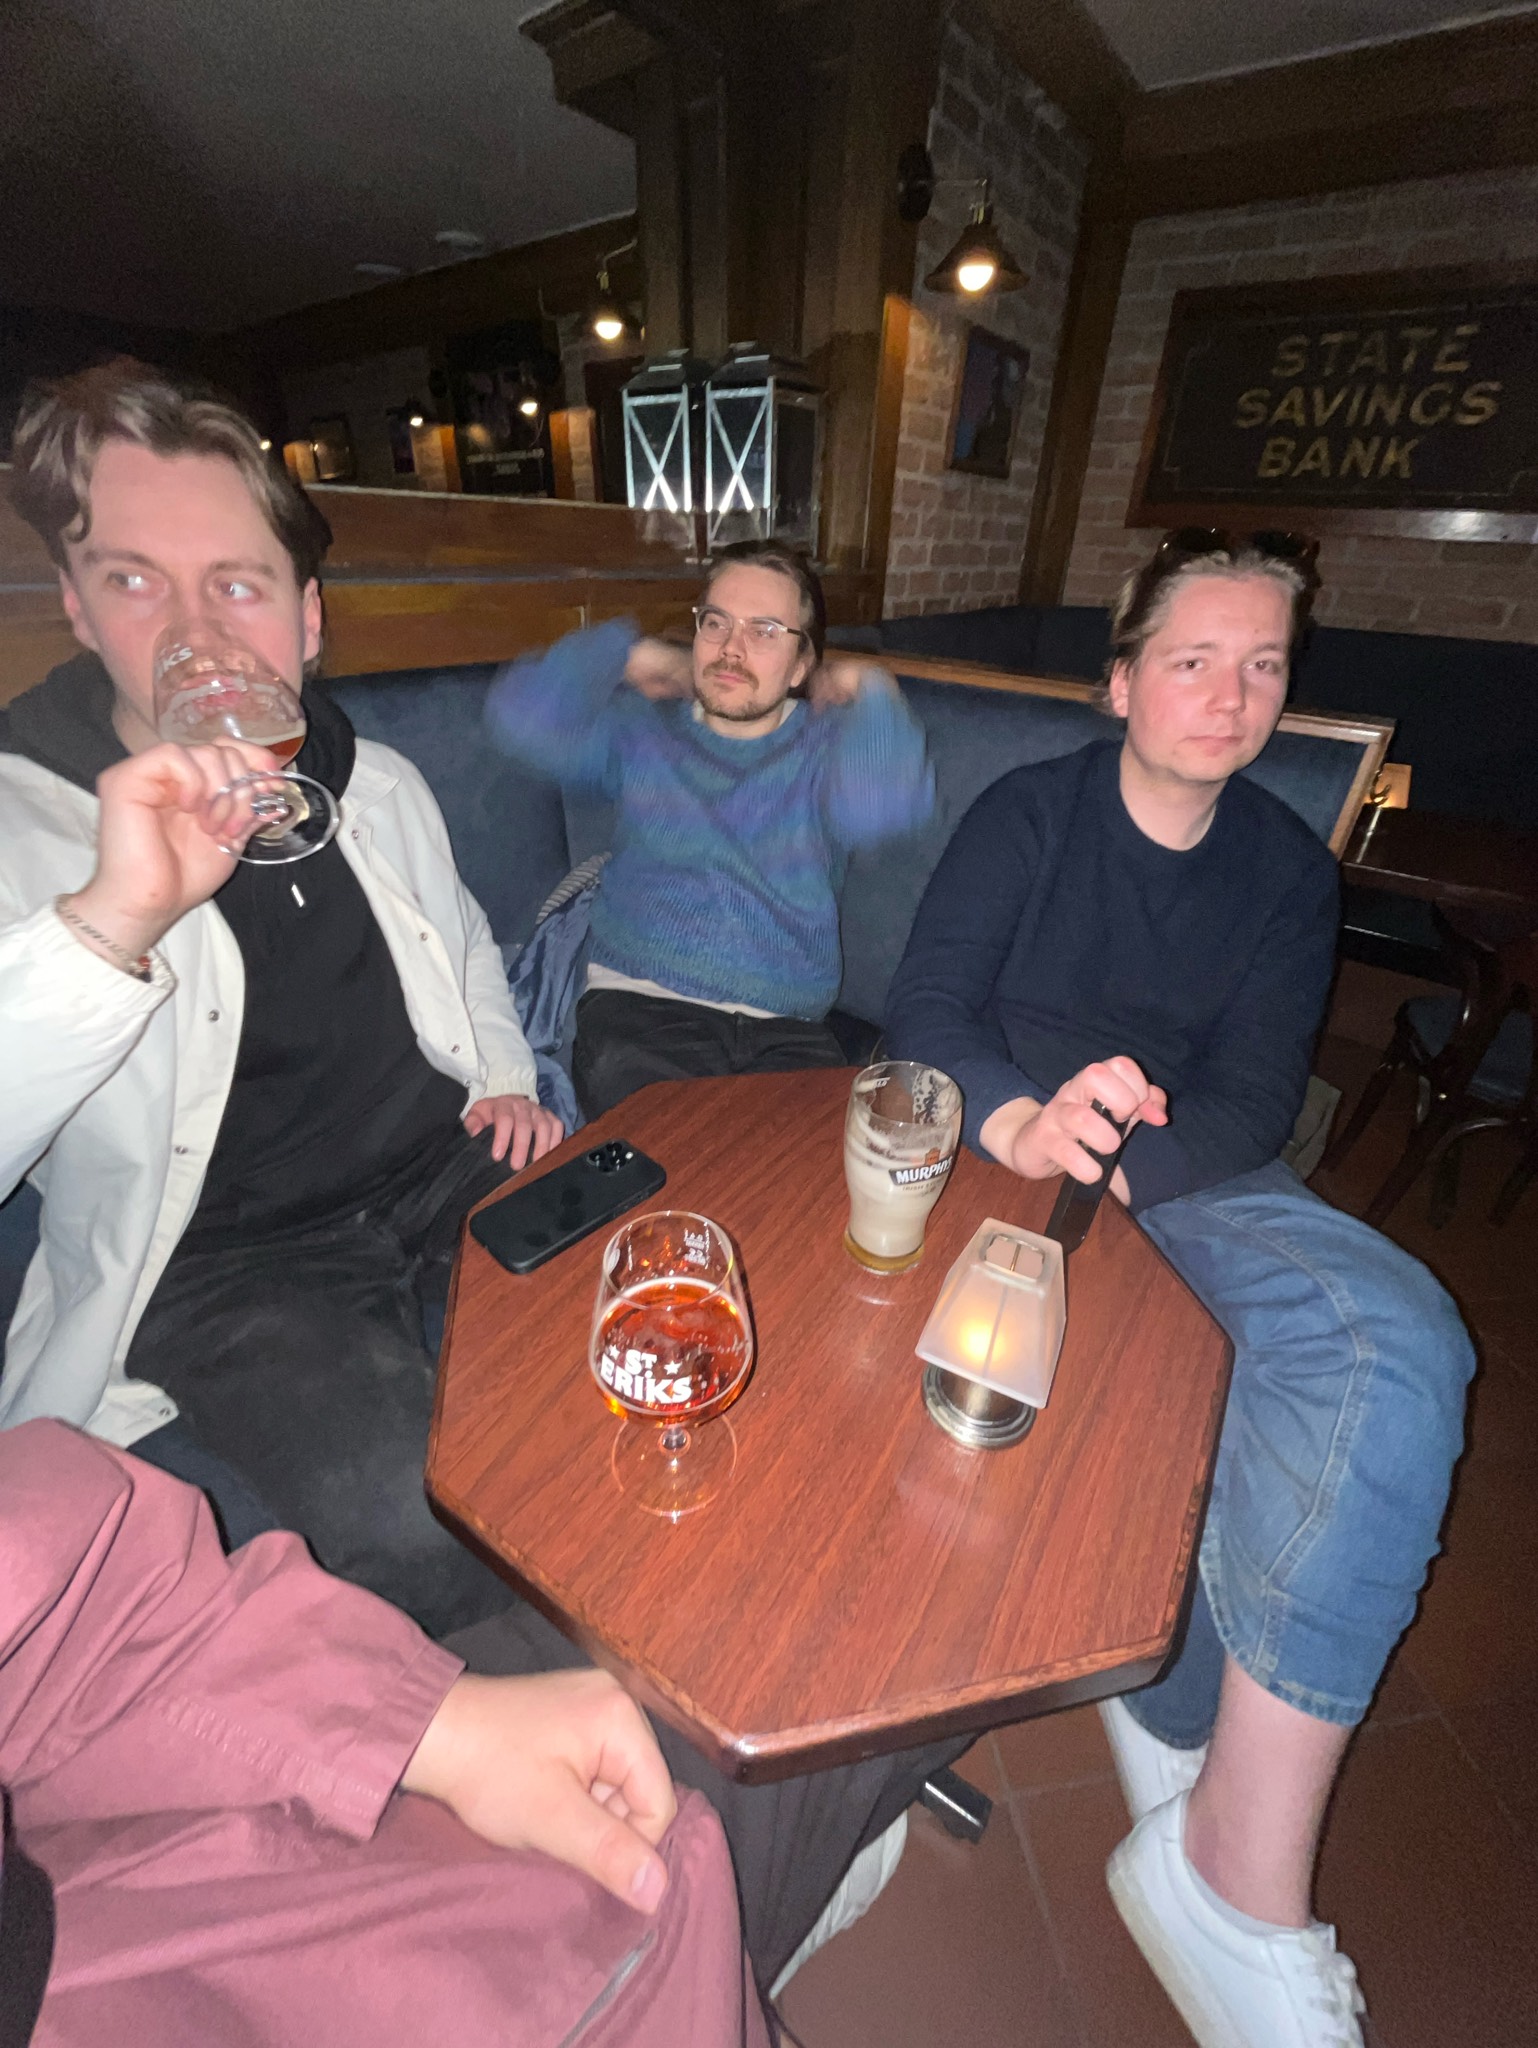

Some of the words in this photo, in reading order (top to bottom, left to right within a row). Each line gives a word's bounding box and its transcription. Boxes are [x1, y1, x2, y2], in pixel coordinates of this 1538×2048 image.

[1271, 322, 1481, 377] STATE
[1236, 381, 1501, 429] SAVINGS
[1257, 435, 1421, 479] BANK
[601, 1353, 692, 1404] ERIKS
